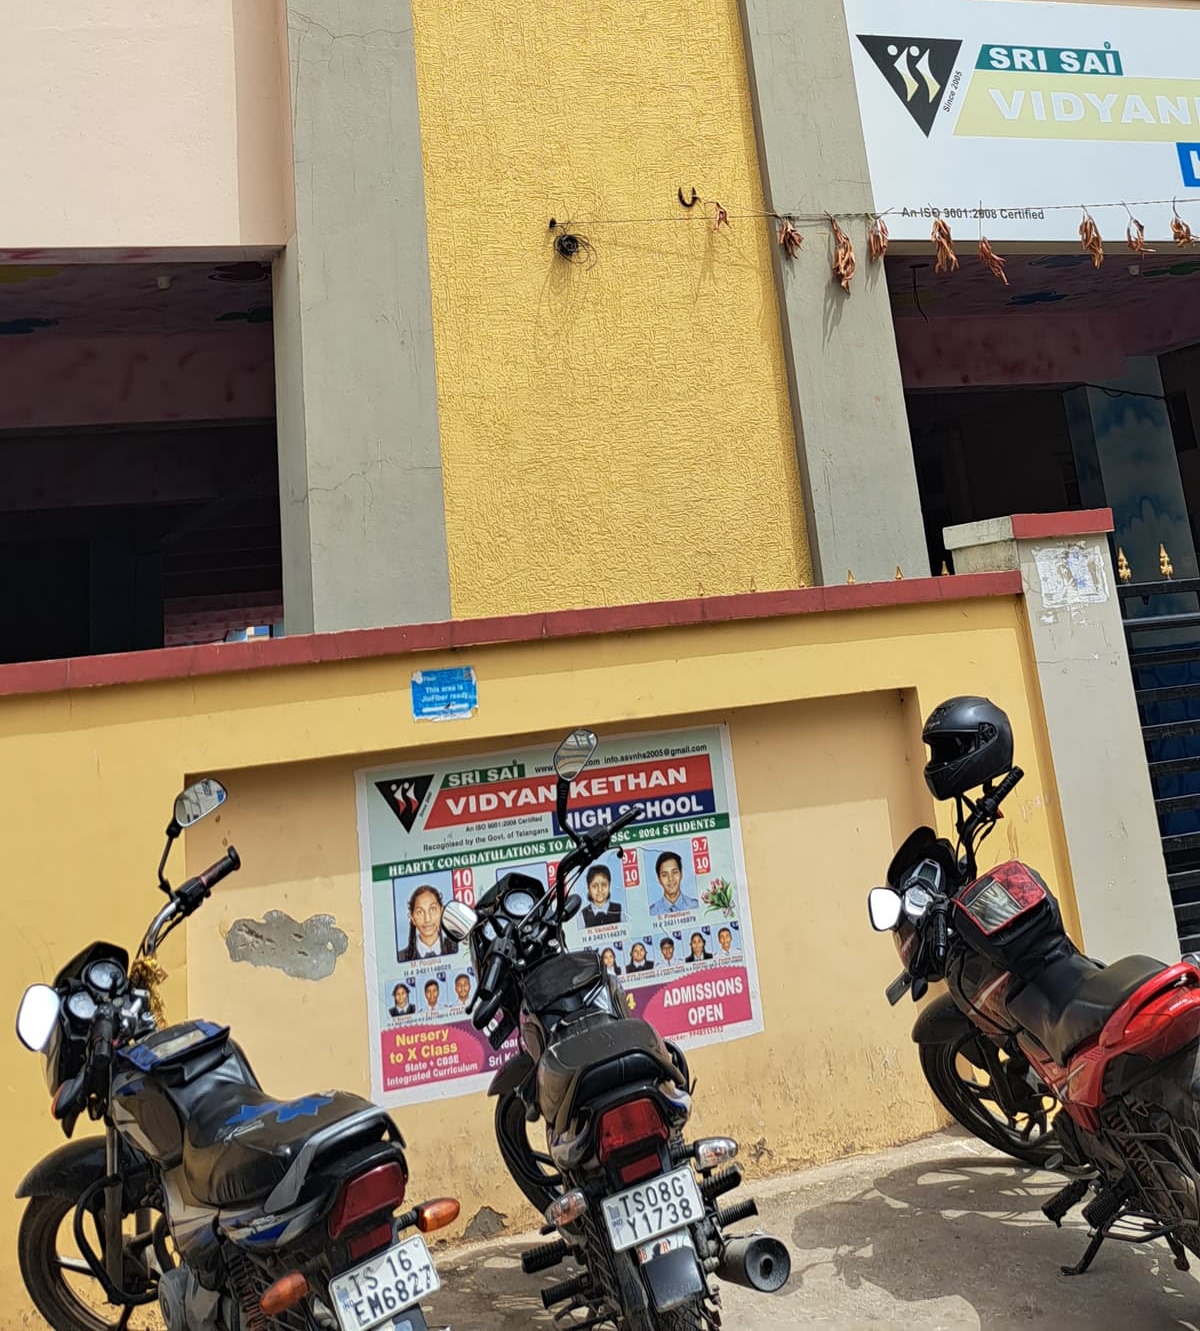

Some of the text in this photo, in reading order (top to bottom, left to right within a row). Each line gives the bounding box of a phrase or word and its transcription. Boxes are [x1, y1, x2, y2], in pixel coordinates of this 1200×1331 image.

[989, 47, 1118, 75] SRI SAI
[943, 70, 962, 112] Since 2005
[902, 207, 916, 218] An
[920, 207, 940, 218] ISO
[1000, 208, 1044, 220] Certified
[421, 692, 469, 702] JioFiber ready
[448, 766, 518, 787] SRI SAI
[475, 824, 487, 832] ISO
[518, 815, 543, 825] Certified
[559, 794, 704, 832] HIGH SCHOOL
[388, 859, 435, 877] HEARTY
[437, 841, 546, 869] CONGRATULATIONS
[549, 839, 563, 851] TO
[639, 825, 661, 838] 2024
[662, 816, 716, 834] STUDENTS
[423, 828, 549, 852] Recognised by the Govt. of Telangana
[692, 839, 708, 852] 9.7
[622, 850, 636, 864] 9.7
[696, 858, 710, 869] 10
[453, 869, 473, 887] 10
[625, 869, 638, 882] 10
[455, 889, 474, 905] 10
[663, 977, 743, 1008] ADMISSIONS
[688, 1003, 724, 1026] OPEN
[395, 1028, 449, 1046] Nursery
[389, 1043, 458, 1064] to X Class
[405, 1061, 427, 1073] State
[437, 1055, 459, 1066] CBSE
[488, 1055, 501, 1068] Sri
[387, 1062, 478, 1086] Integrated Curriculum
[619, 1176, 685, 1217] TS08G
[626, 1198, 693, 1240] Y1738
[348, 1249, 412, 1297] TS 16
[354, 1264, 430, 1327] EM6827
